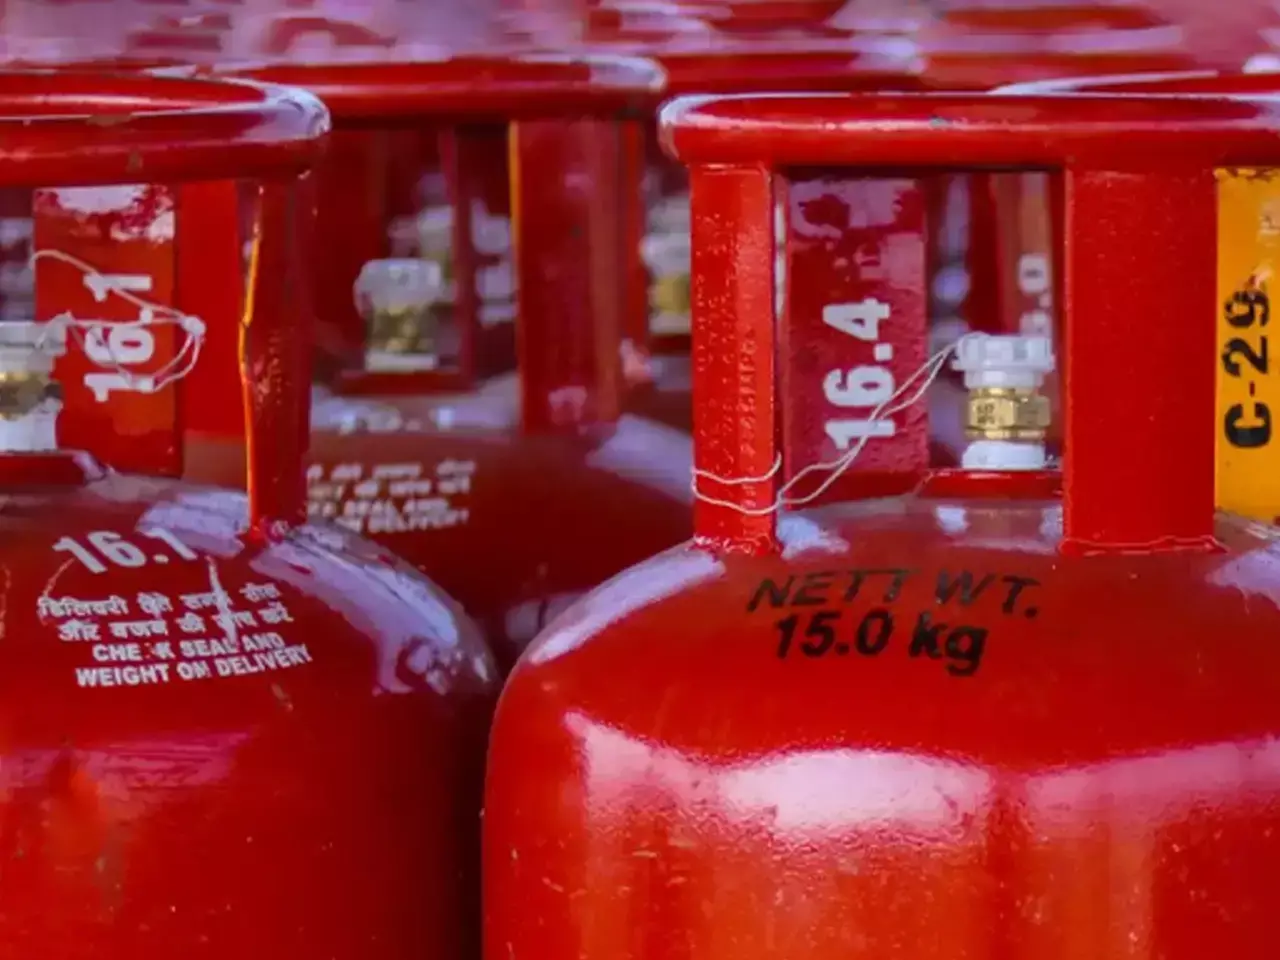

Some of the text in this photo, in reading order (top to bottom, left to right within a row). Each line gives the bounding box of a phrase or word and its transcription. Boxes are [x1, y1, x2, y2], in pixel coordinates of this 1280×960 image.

[83, 274, 154, 402] 16.1
[1221, 287, 1272, 449] C-29
[822, 297, 896, 450] 16.4
[52, 528, 198, 574] 16.1
[746, 567, 1042, 619] NETT WT.
[75, 642, 314, 688] WEIGHT ON DELIVERY
[92, 631, 286, 663] CHEK SEAL AND
[773, 608, 989, 677] 15.0 kg
